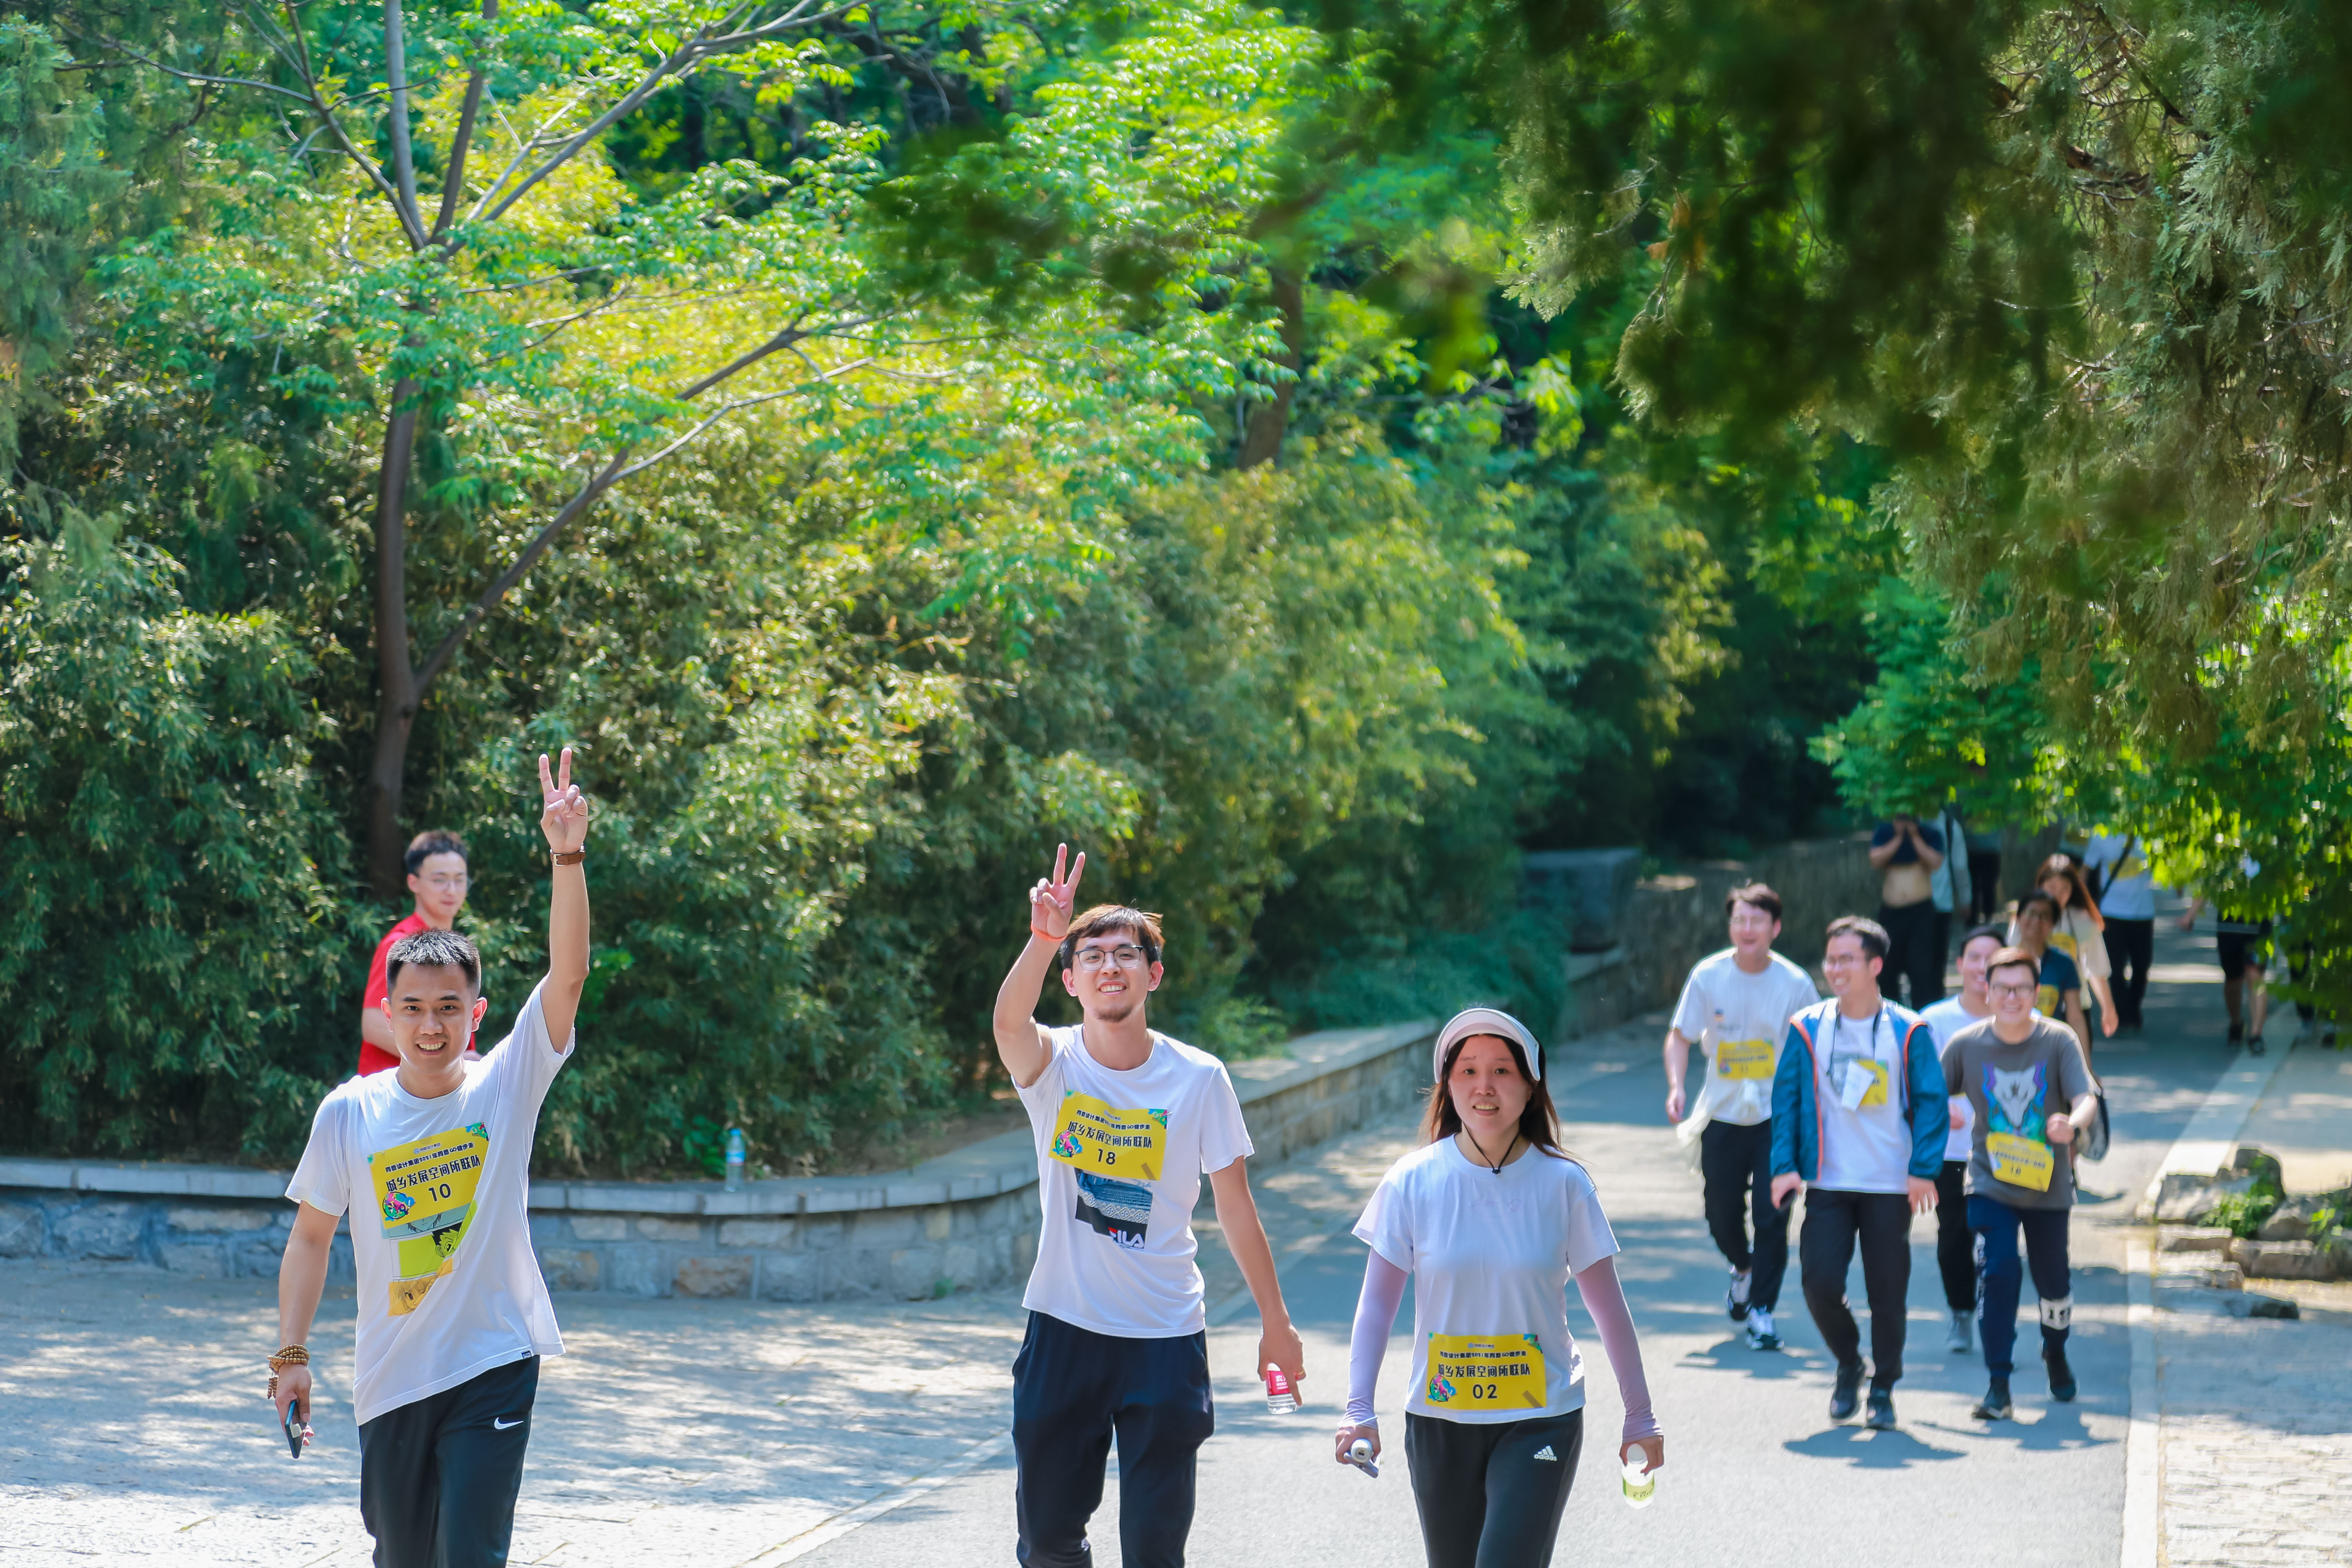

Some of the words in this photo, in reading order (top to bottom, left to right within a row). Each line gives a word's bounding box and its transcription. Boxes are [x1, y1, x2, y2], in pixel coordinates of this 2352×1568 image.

[1098, 1149, 1116, 1165] 18
[386, 1154, 481, 1192] 城乡发展空间所联队
[428, 1183, 451, 1202] 10
[1108, 1227, 1144, 1248] FILA
[1472, 1384, 1497, 1399] 02
